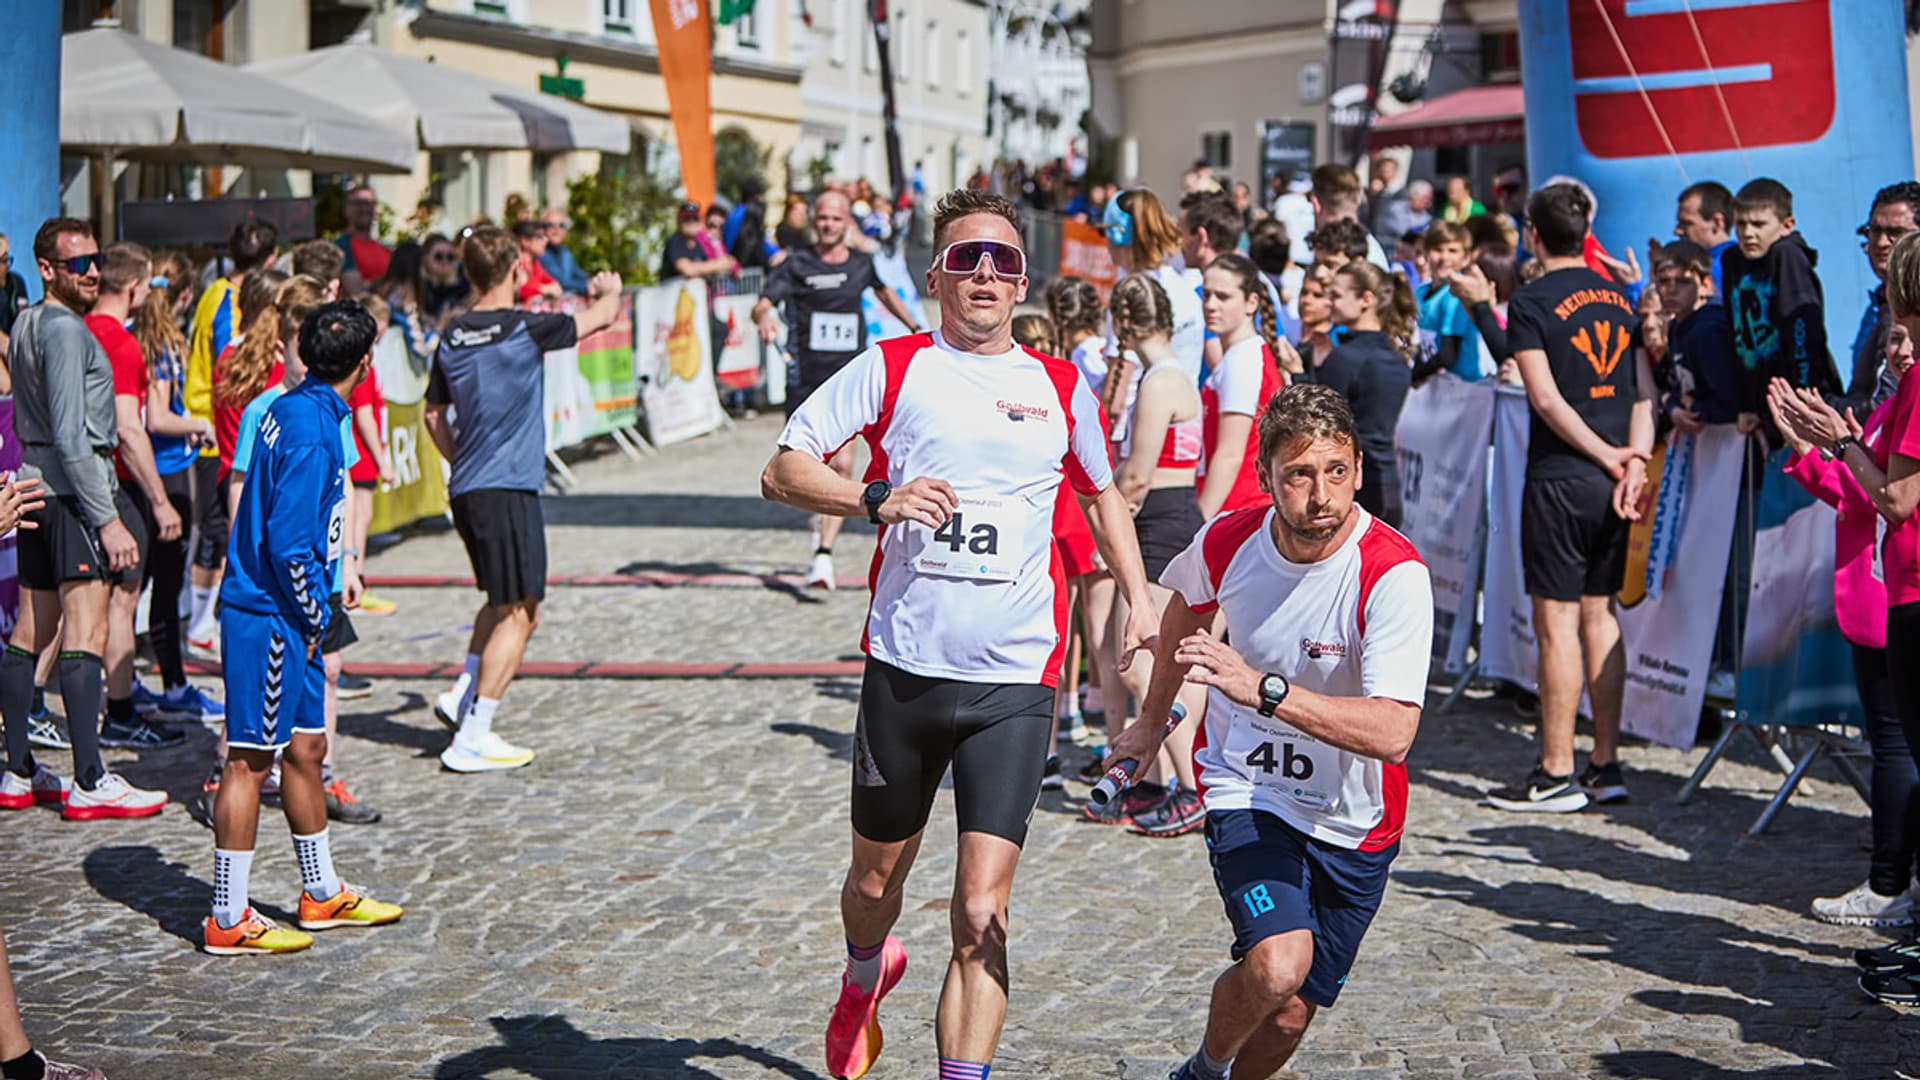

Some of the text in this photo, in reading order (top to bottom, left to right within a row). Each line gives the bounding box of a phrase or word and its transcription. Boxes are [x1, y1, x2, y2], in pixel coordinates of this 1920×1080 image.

[934, 512, 999, 556] 4a
[1246, 741, 1315, 781] 4b
[1243, 884, 1275, 919] 18
